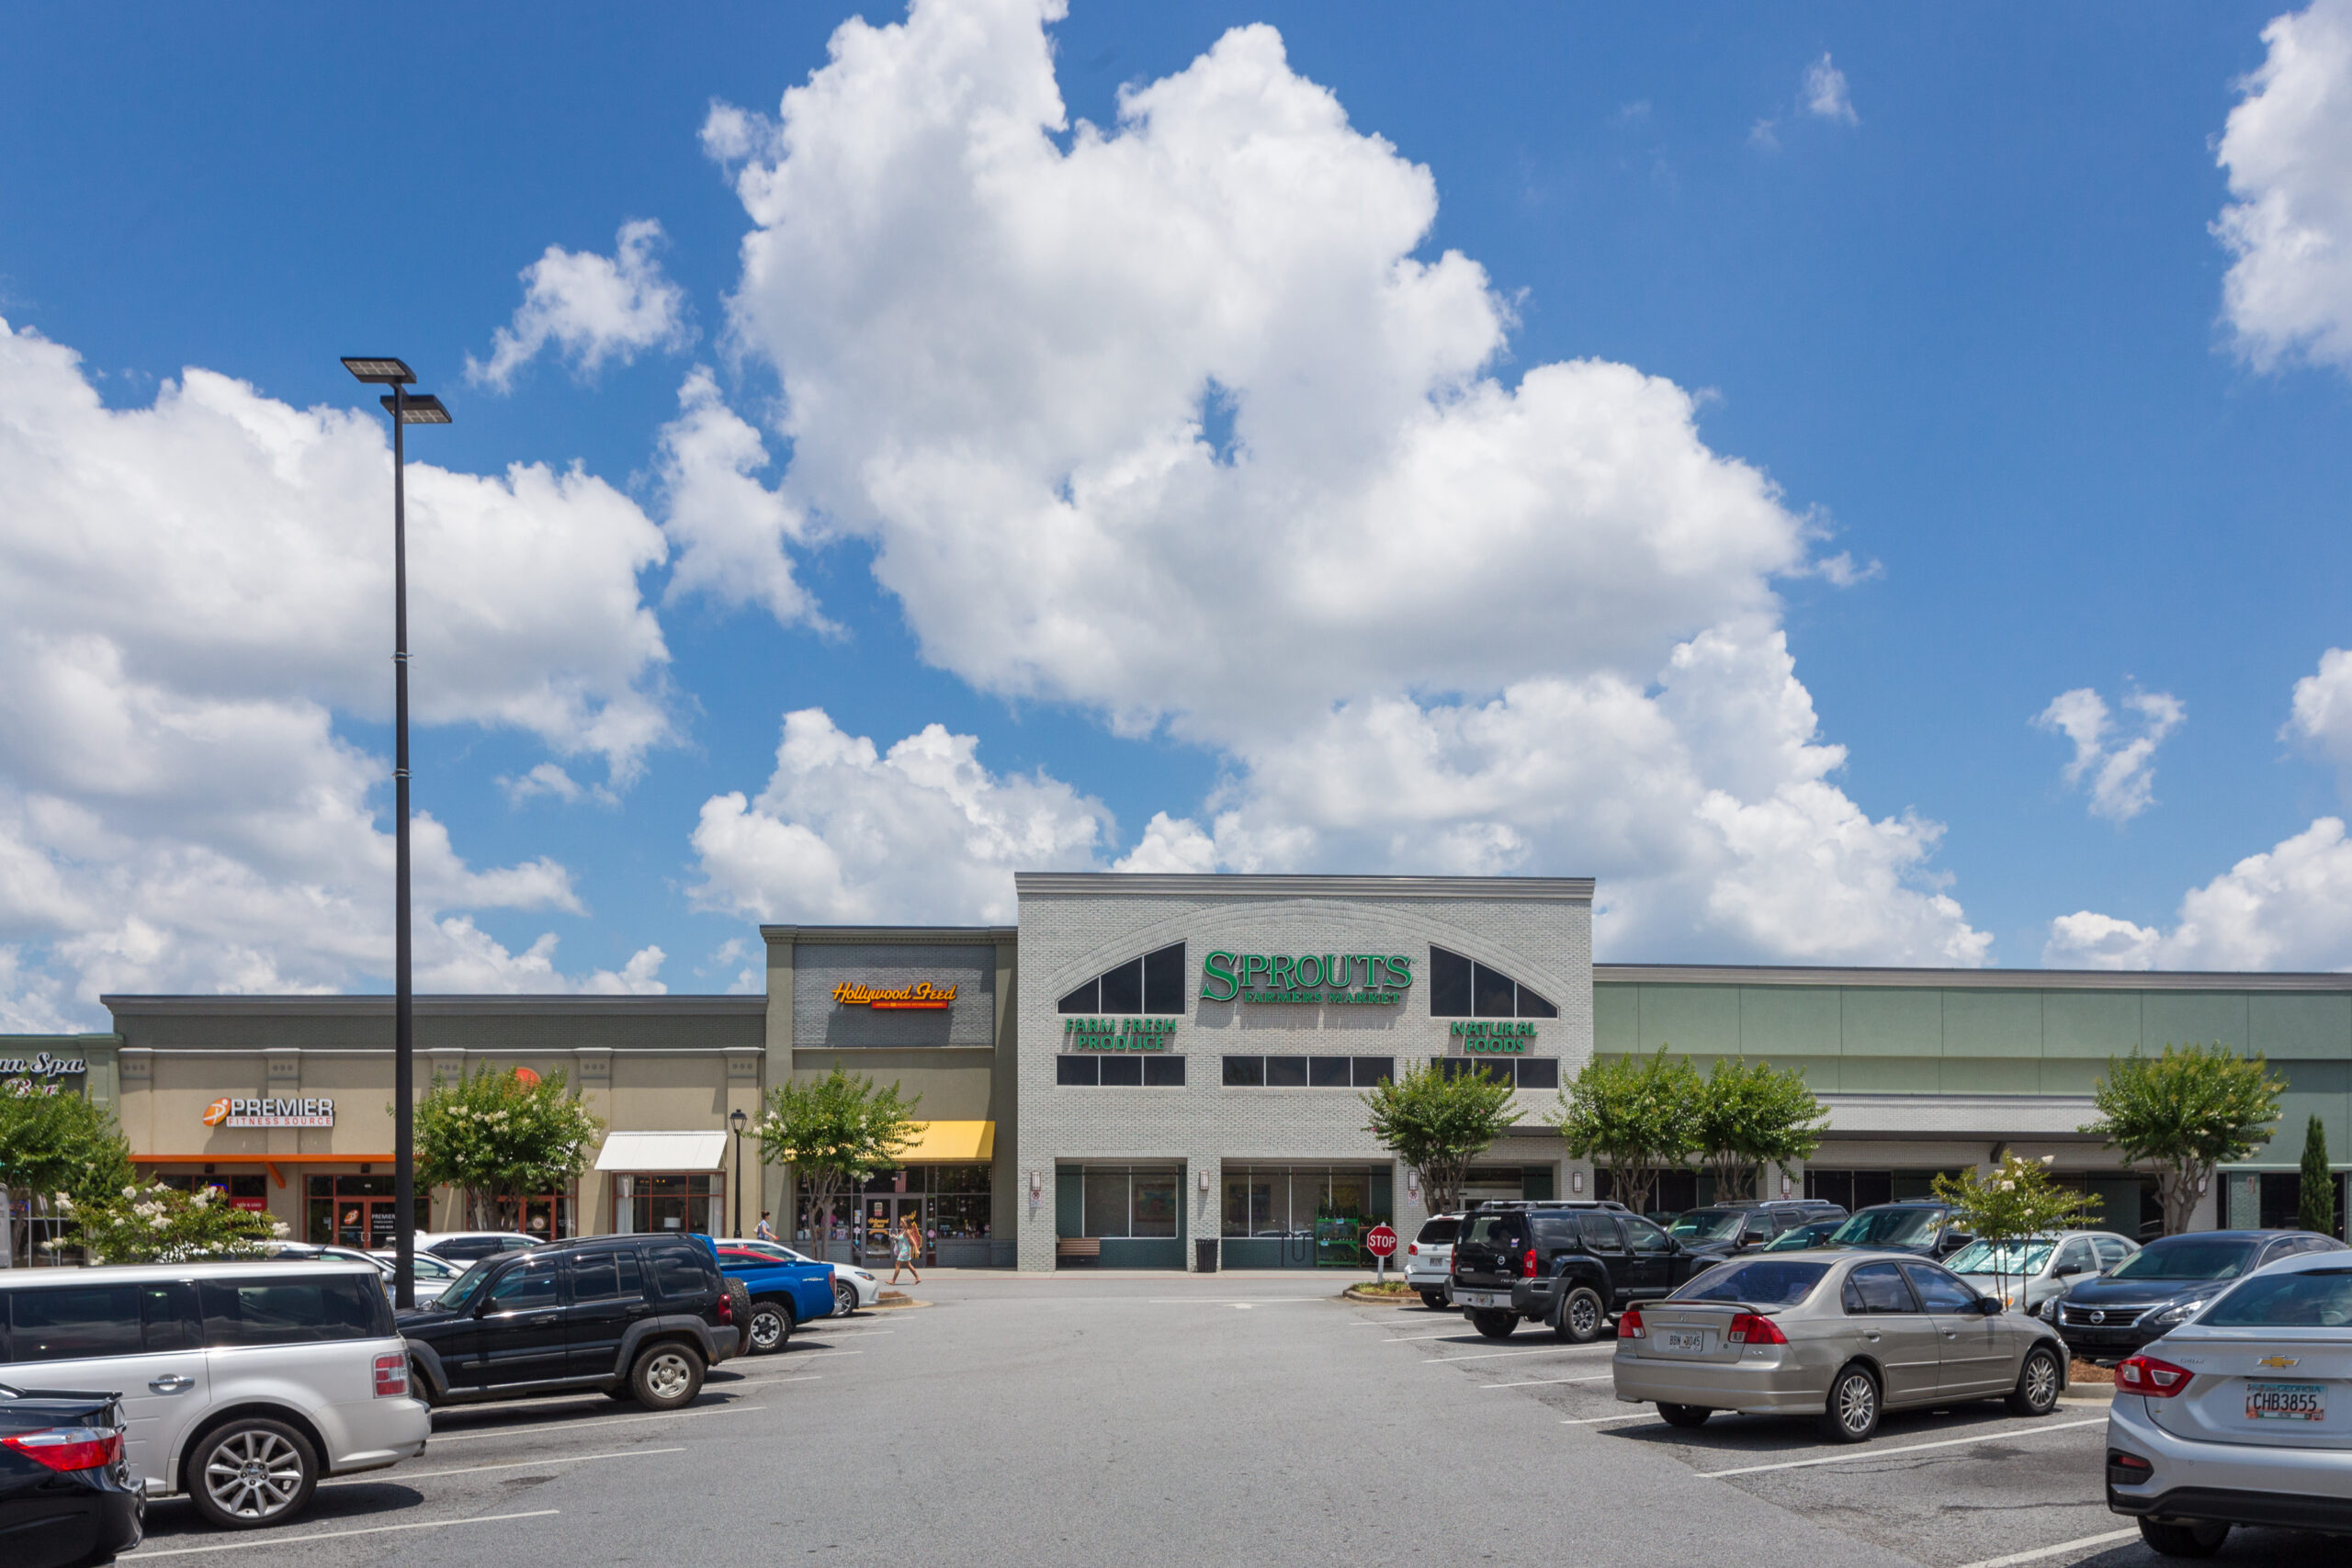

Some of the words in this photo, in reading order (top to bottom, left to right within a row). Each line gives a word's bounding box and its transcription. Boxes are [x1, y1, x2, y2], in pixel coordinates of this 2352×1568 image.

[1199, 950, 1414, 1002] SPROUTS
[831, 981, 912, 1004] Hollywood
[912, 981, 957, 1001] Feed
[1243, 991, 1324, 1005] FARMERS
[1328, 991, 1401, 1005] MARKET
[1066, 1018, 1116, 1033] FARM
[1123, 1018, 1177, 1033] FRESH
[1452, 1021, 1539, 1037] NATURAL
[1077, 1034, 1165, 1050] PRODUCE
[1465, 1037, 1525, 1053] FOODS
[29, 1051, 87, 1077] Spa
[230, 1098, 335, 1117] PREMIER
[228, 1116, 279, 1125] FITNESS
[284, 1116, 333, 1125] SOURCE
[1369, 1235, 1396, 1248] STOP
[2253, 1393, 2317, 1412] CHB3855
